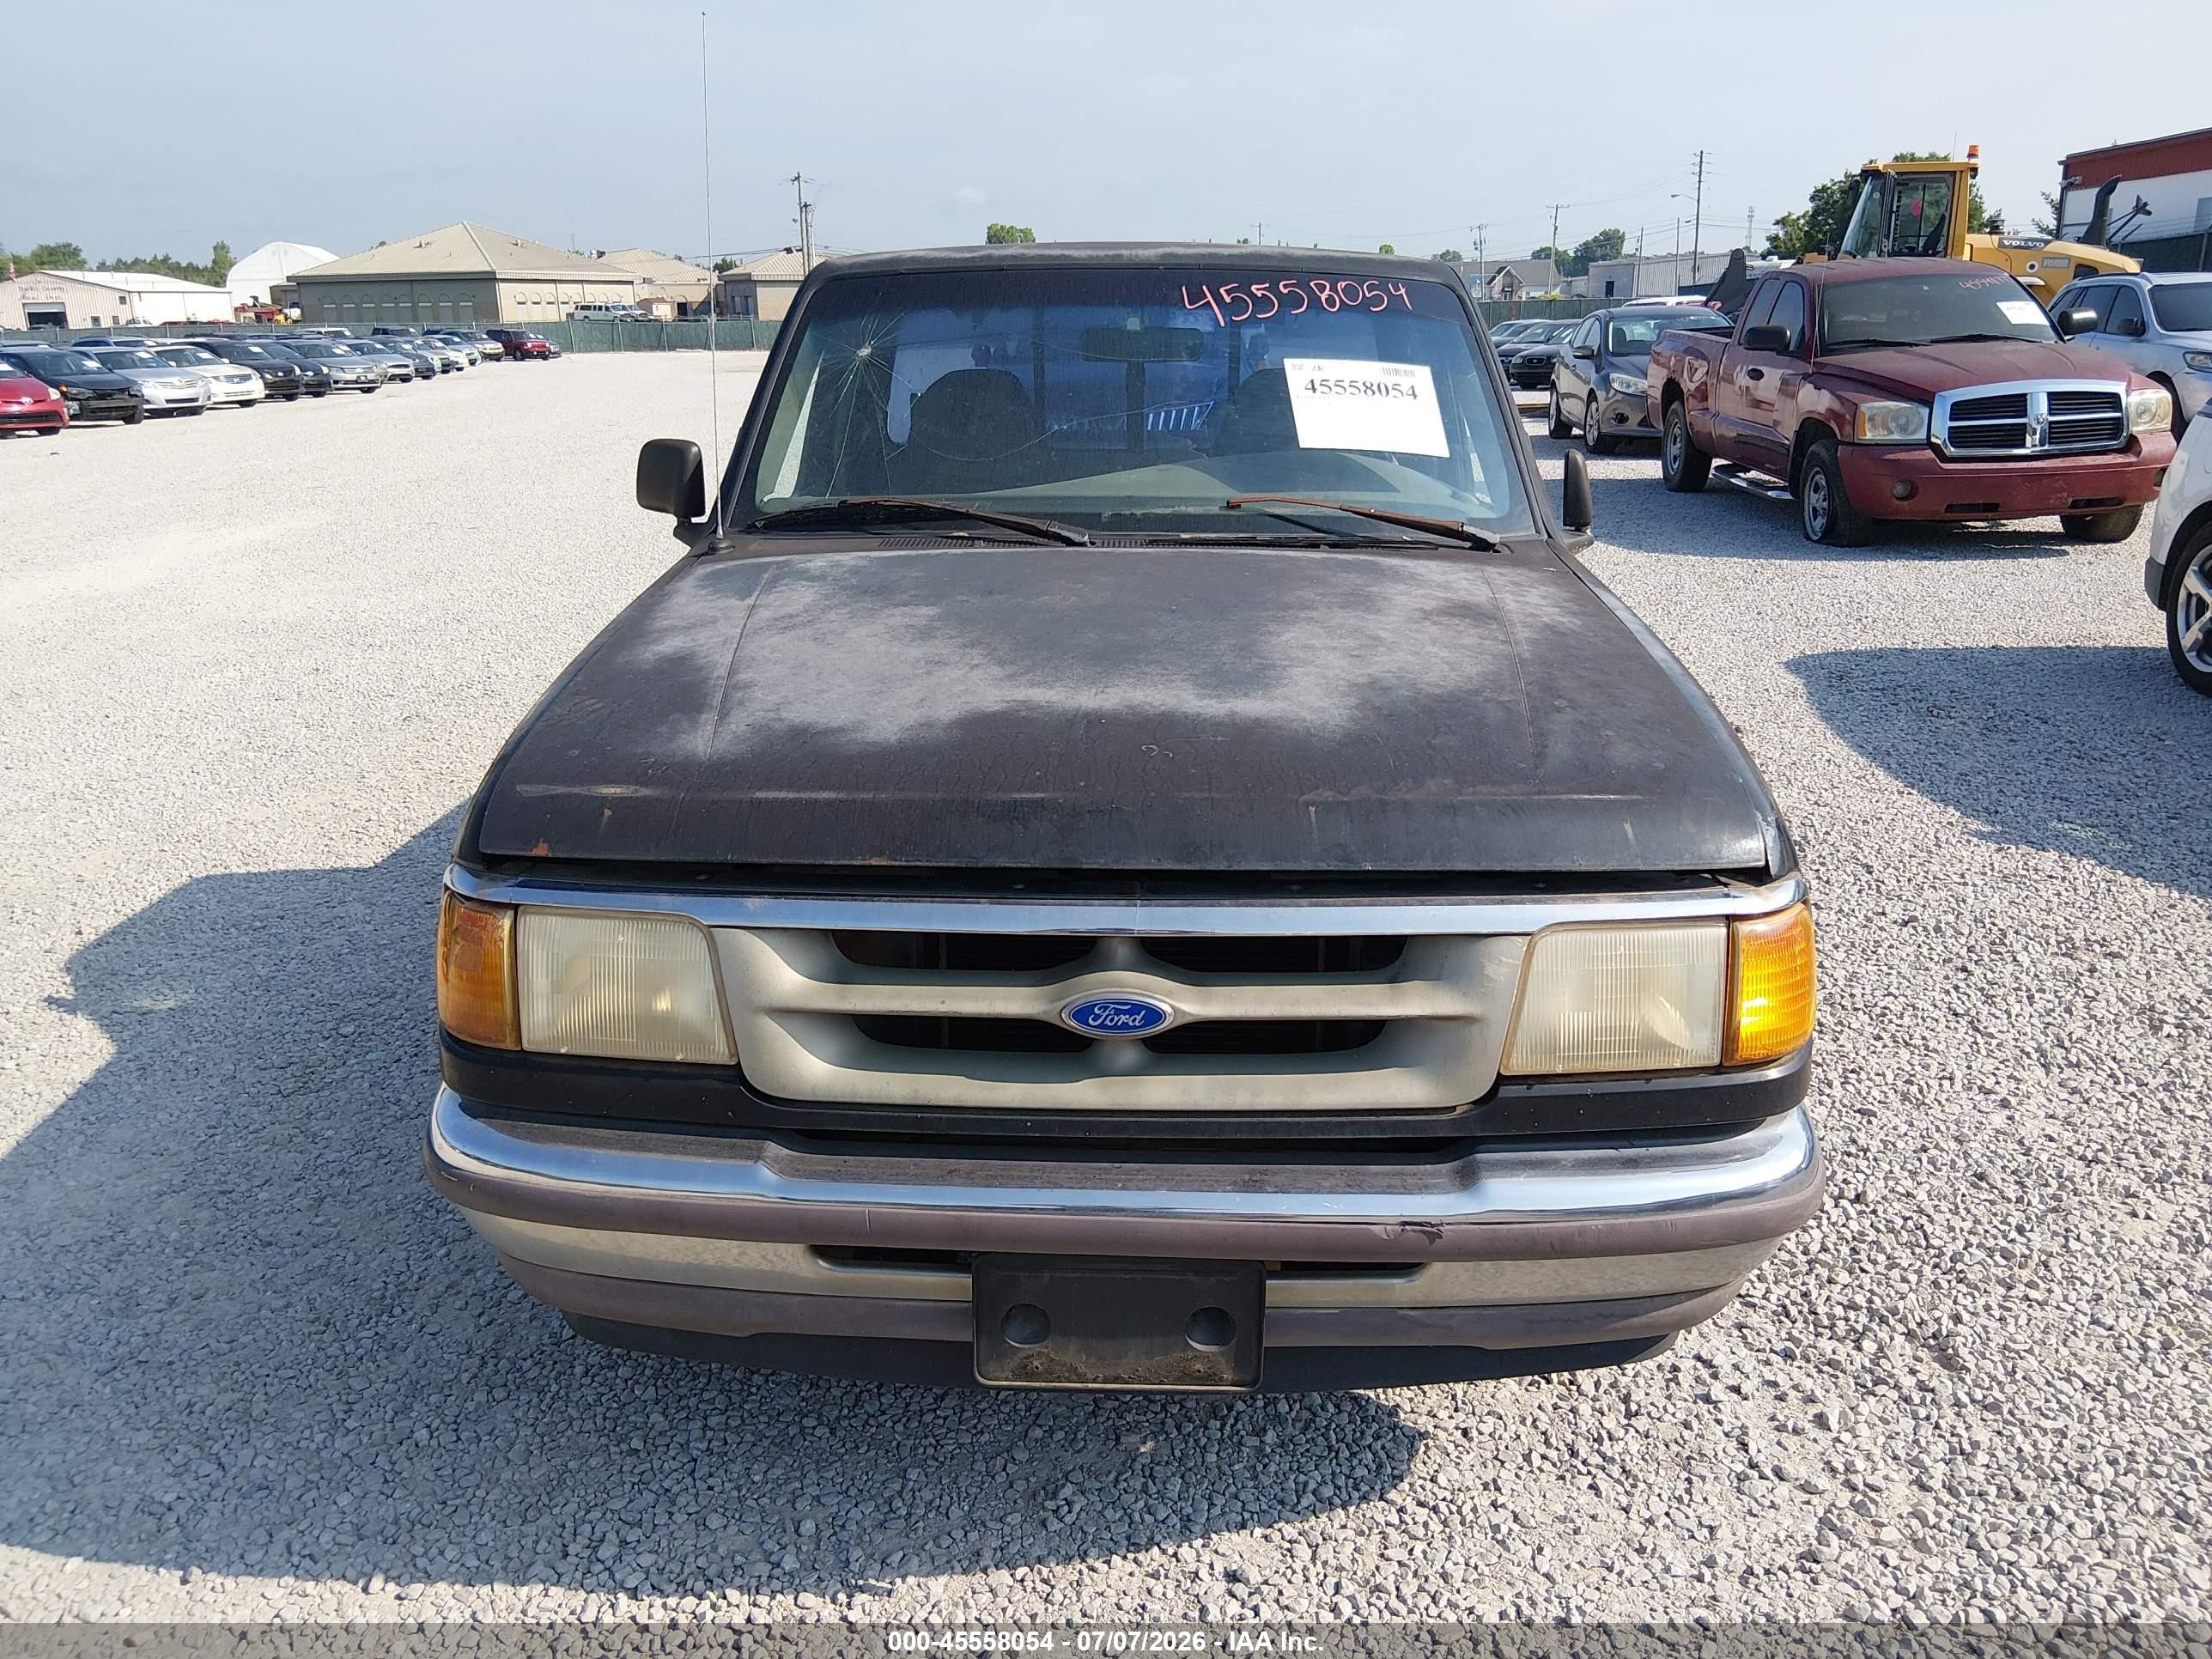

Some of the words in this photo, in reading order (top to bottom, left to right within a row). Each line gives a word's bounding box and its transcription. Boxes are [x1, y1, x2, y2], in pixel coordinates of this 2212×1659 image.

[2002, 240, 2045, 248] VOLVO
[1182, 280, 1413, 327] 45558054
[1304, 378, 1419, 401] 45558054
[1088, 1003, 1146, 1026] Ford
